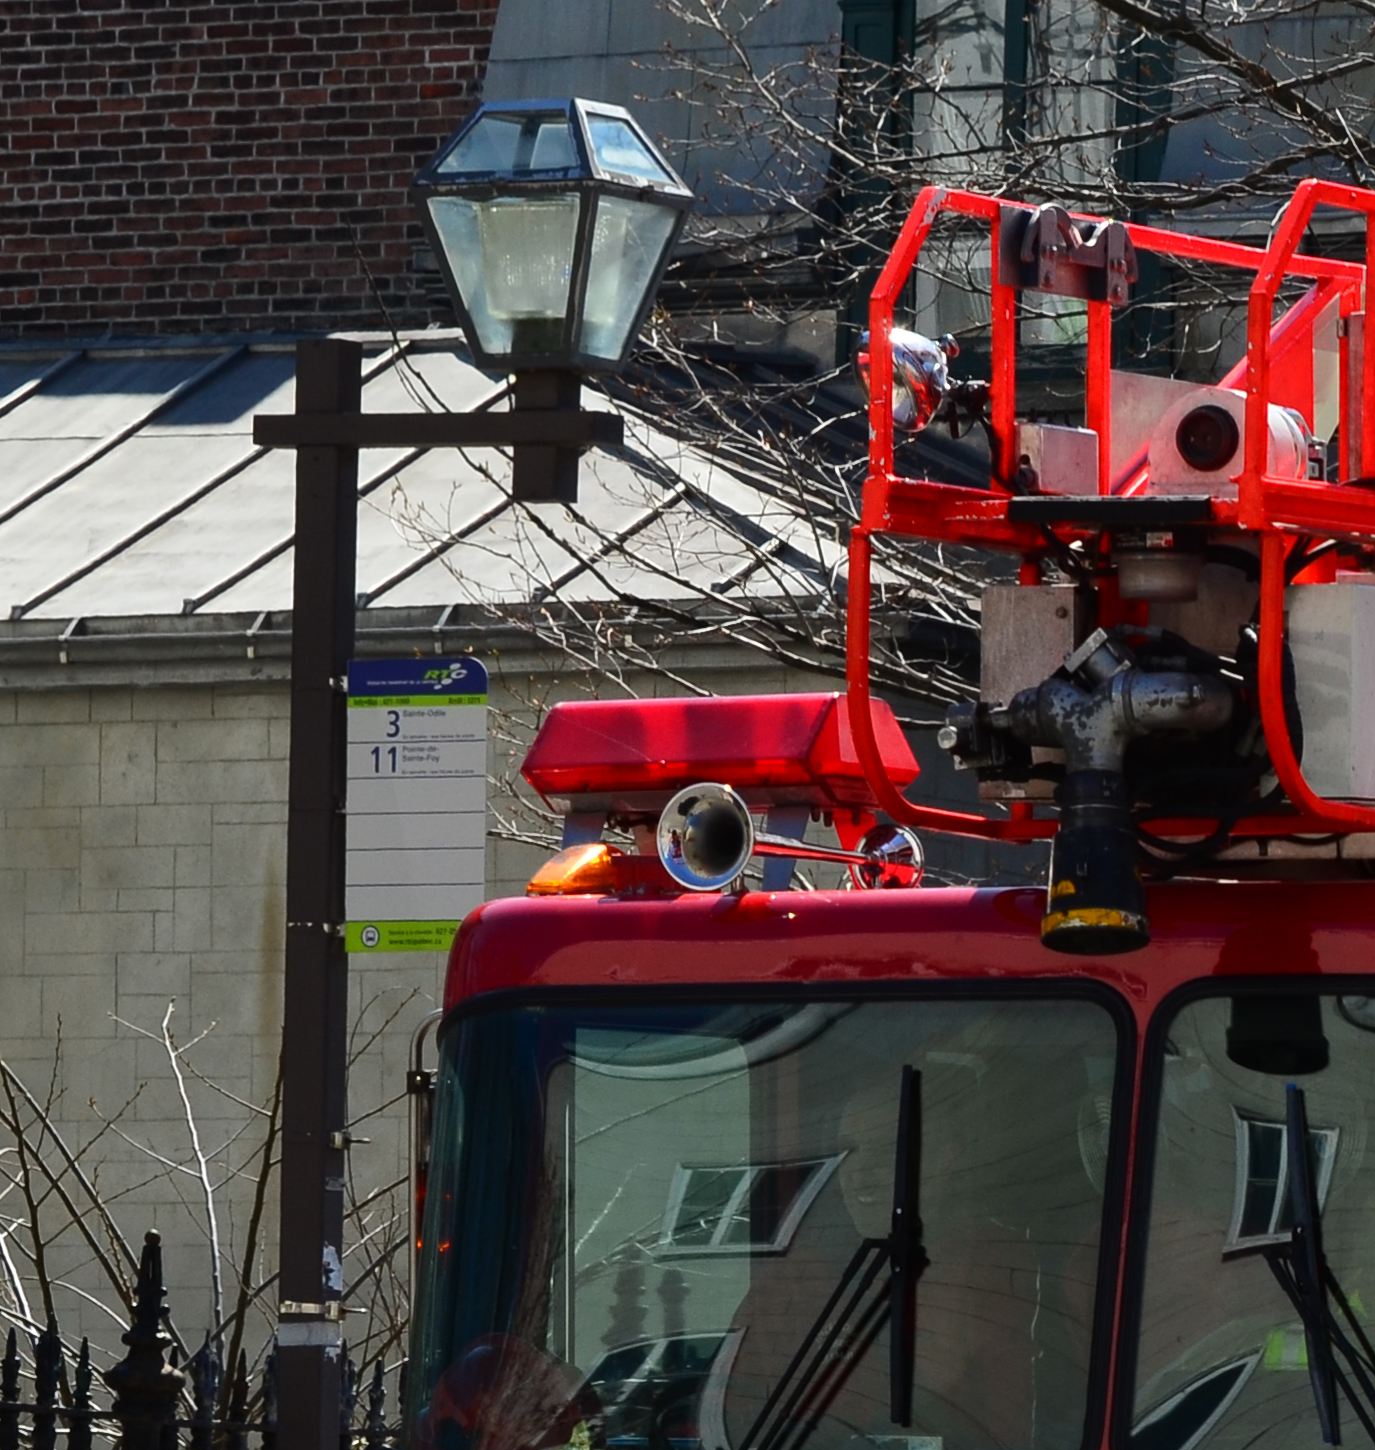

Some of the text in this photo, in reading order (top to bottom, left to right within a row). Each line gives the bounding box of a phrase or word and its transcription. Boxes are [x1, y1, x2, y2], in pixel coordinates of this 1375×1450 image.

[424, 669, 468, 680] RTC
[386, 710, 401, 738] 3
[370, 745, 397, 774] 11
